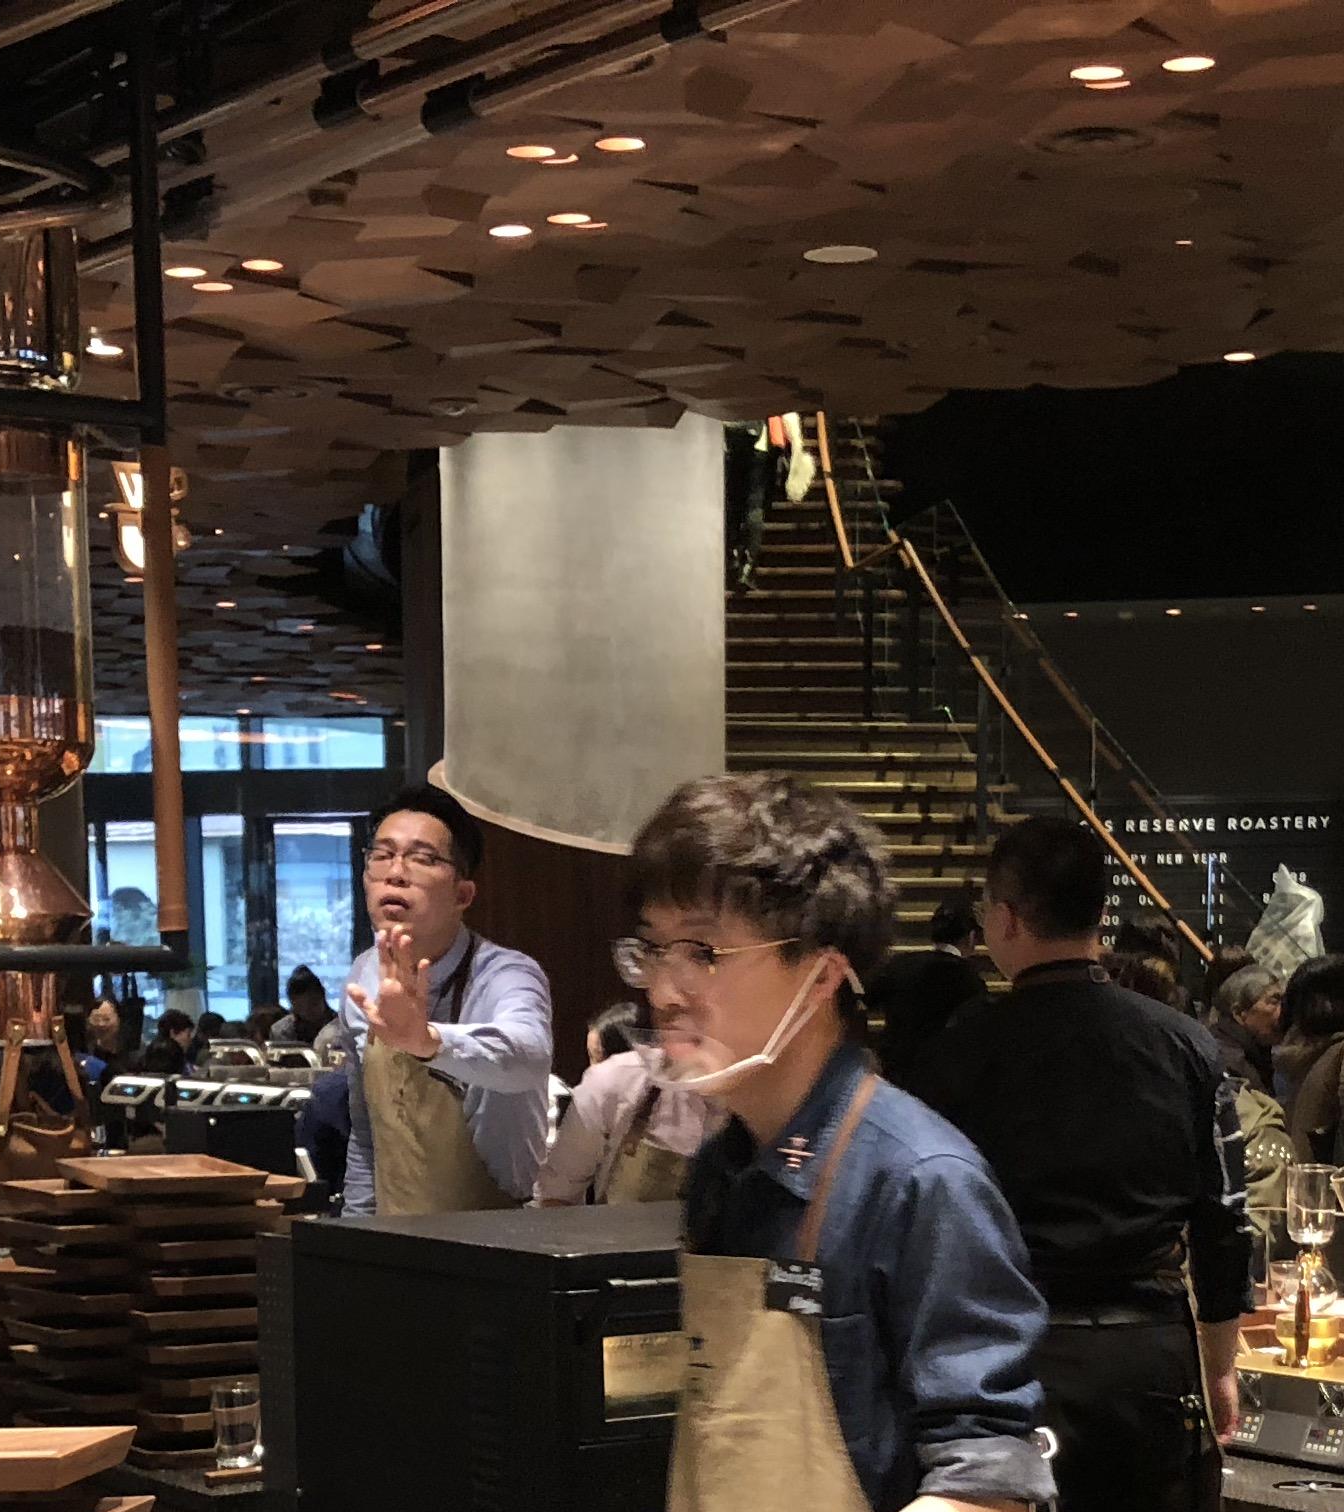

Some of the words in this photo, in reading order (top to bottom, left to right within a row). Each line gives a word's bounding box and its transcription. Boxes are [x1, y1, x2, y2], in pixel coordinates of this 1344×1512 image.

[1125, 818, 1216, 833] RESERVE
[1227, 816, 1331, 831] ROASTERY
[1157, 853, 1184, 865] NEW
